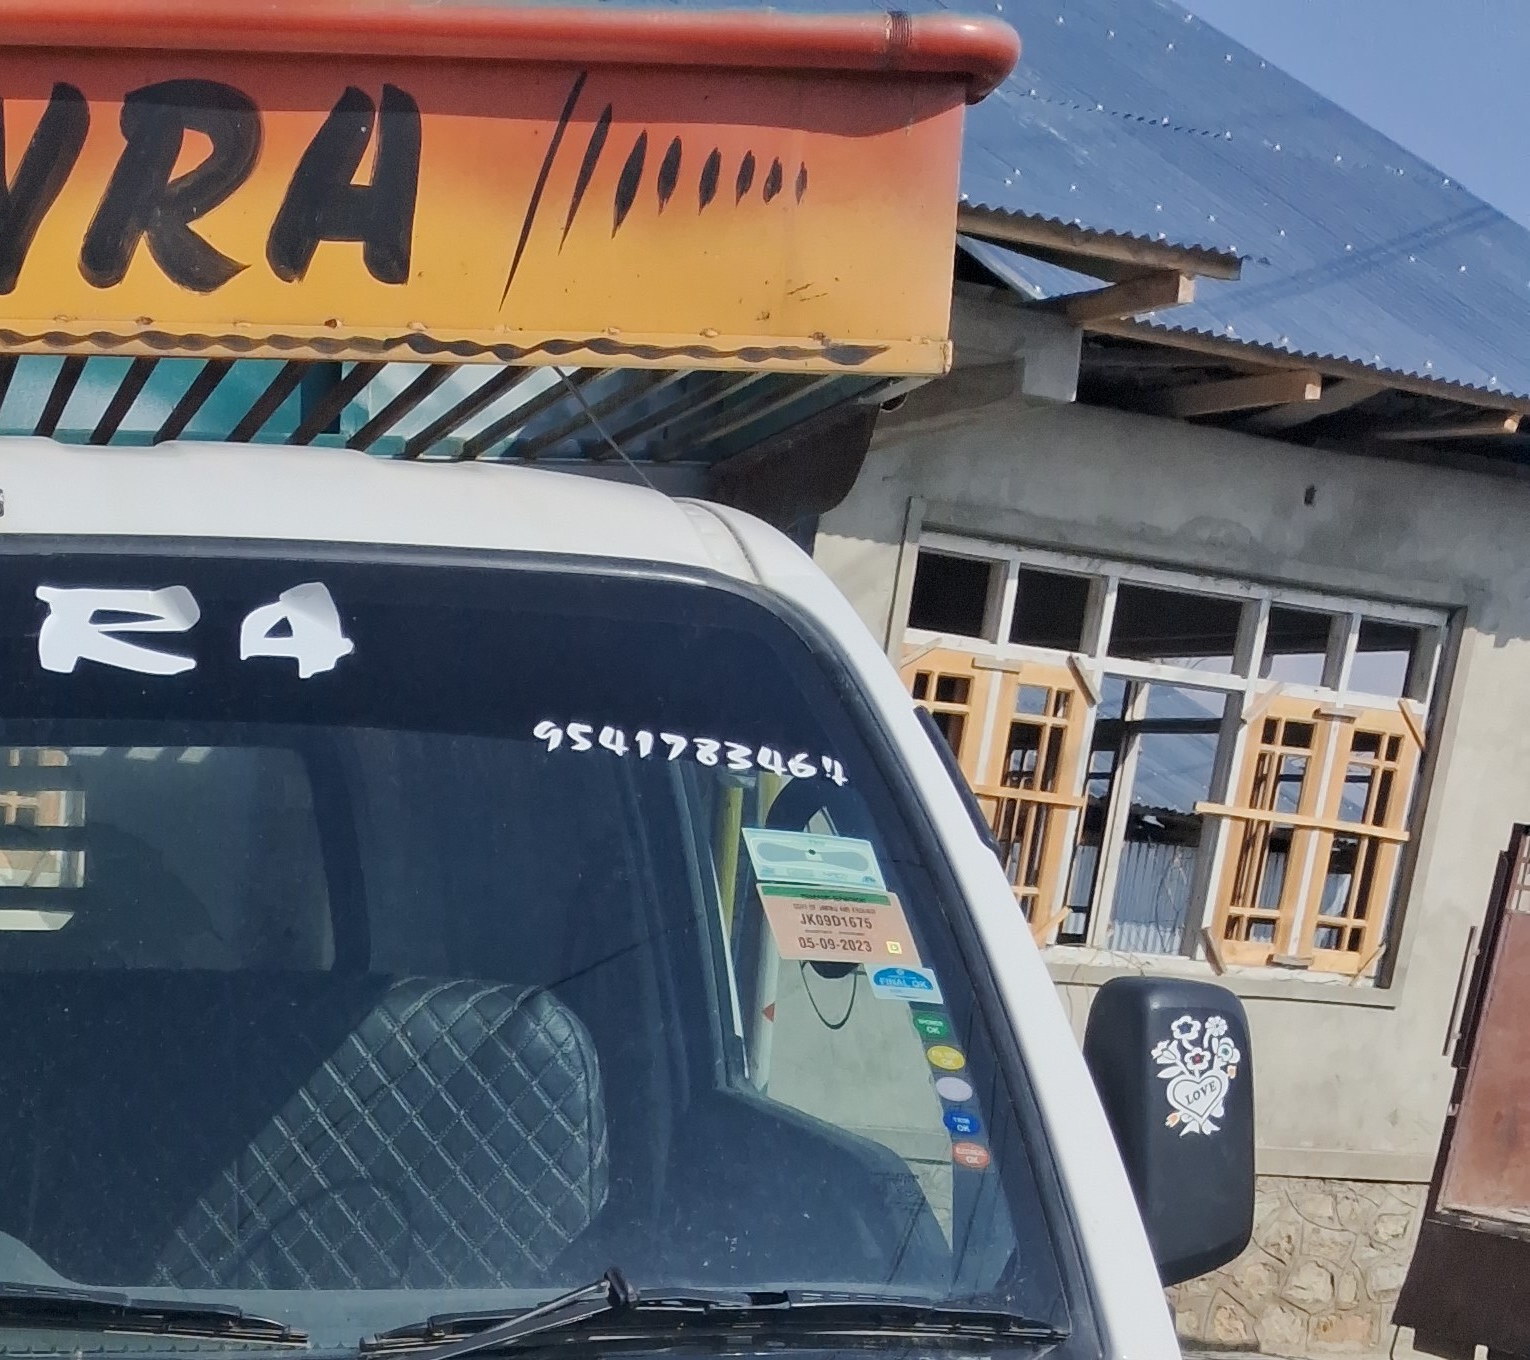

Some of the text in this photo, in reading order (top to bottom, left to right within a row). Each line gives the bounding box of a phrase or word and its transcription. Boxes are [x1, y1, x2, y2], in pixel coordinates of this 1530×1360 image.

[800, 913, 873, 930] JK09D1675
[797, 936, 873, 953] 05-09-2023
[911, 979, 930, 990] OK
[1184, 1080, 1218, 1105] LOVE
